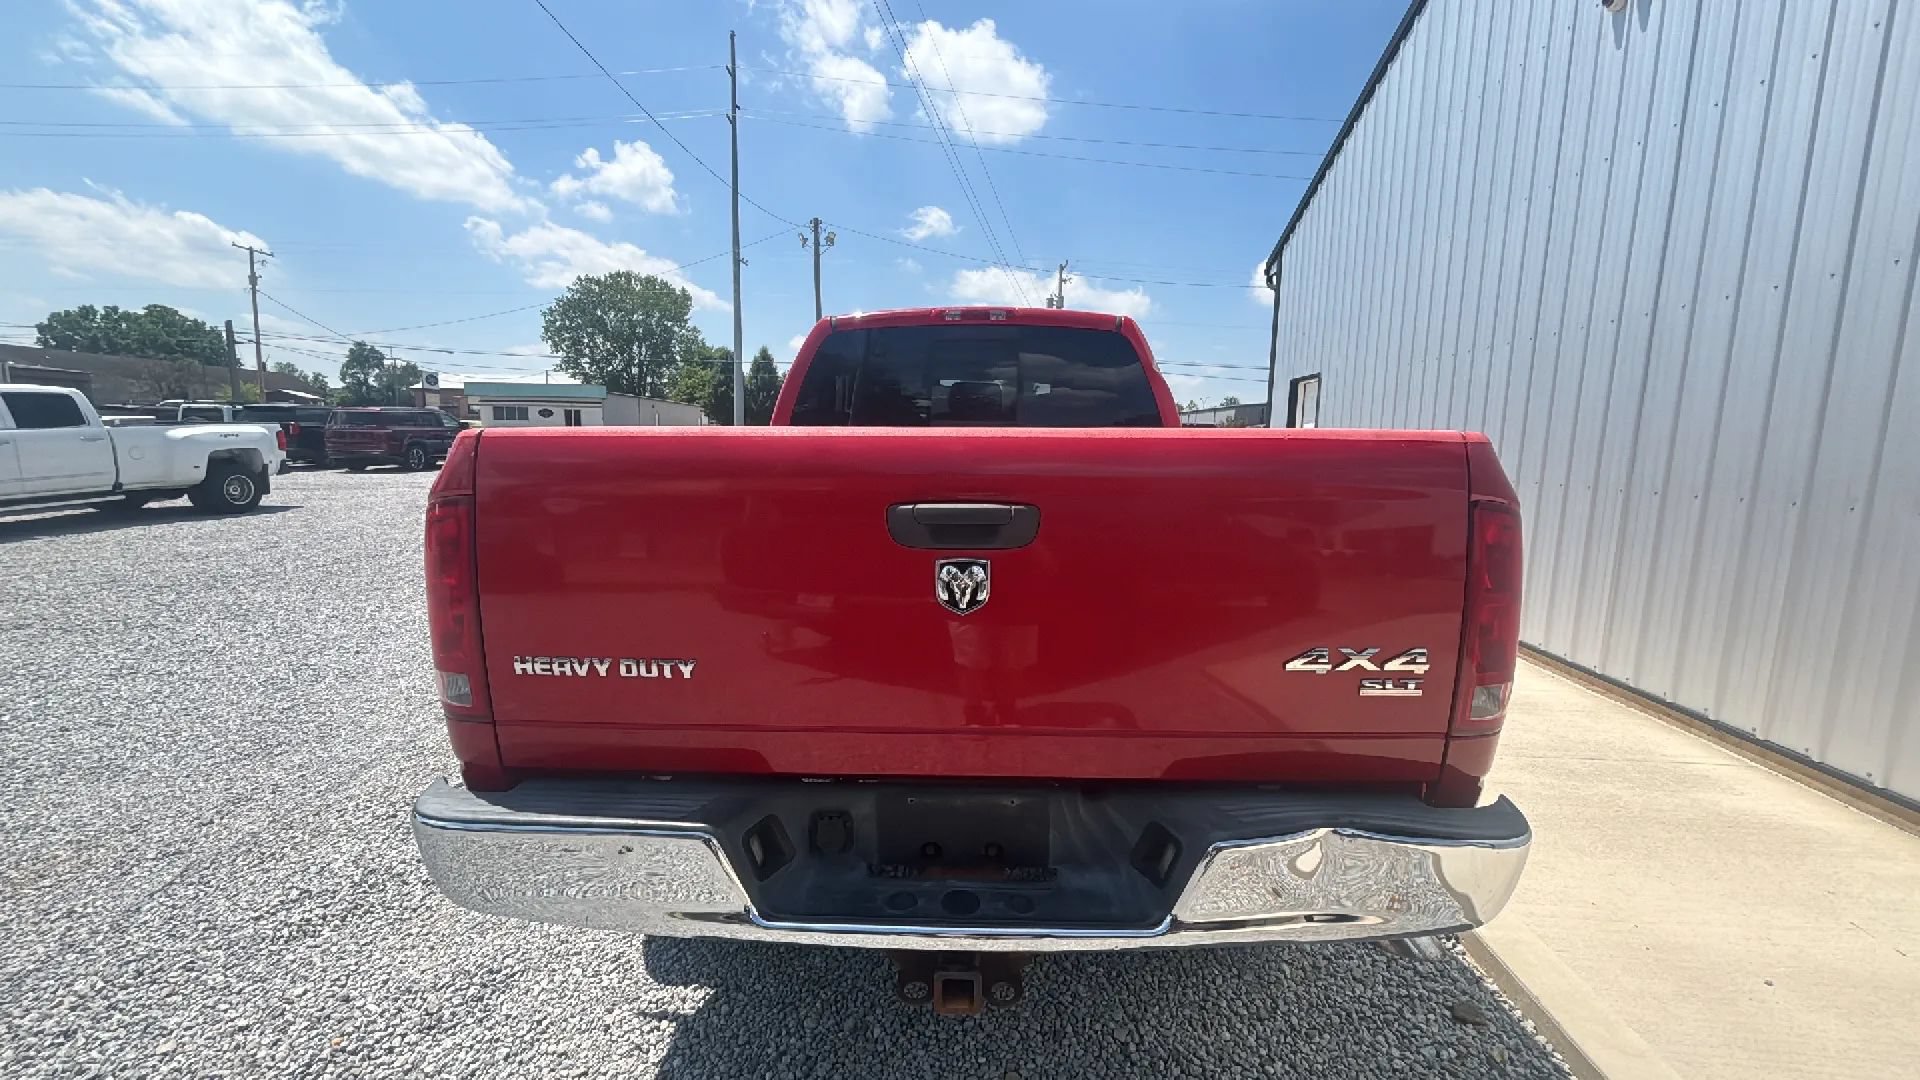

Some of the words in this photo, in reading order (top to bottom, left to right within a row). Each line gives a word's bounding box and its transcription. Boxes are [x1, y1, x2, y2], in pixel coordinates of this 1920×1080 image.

[513, 656, 612, 677] HEAVY
[619, 658, 697, 679] DUTY
[1360, 679, 1424, 692] SLT
